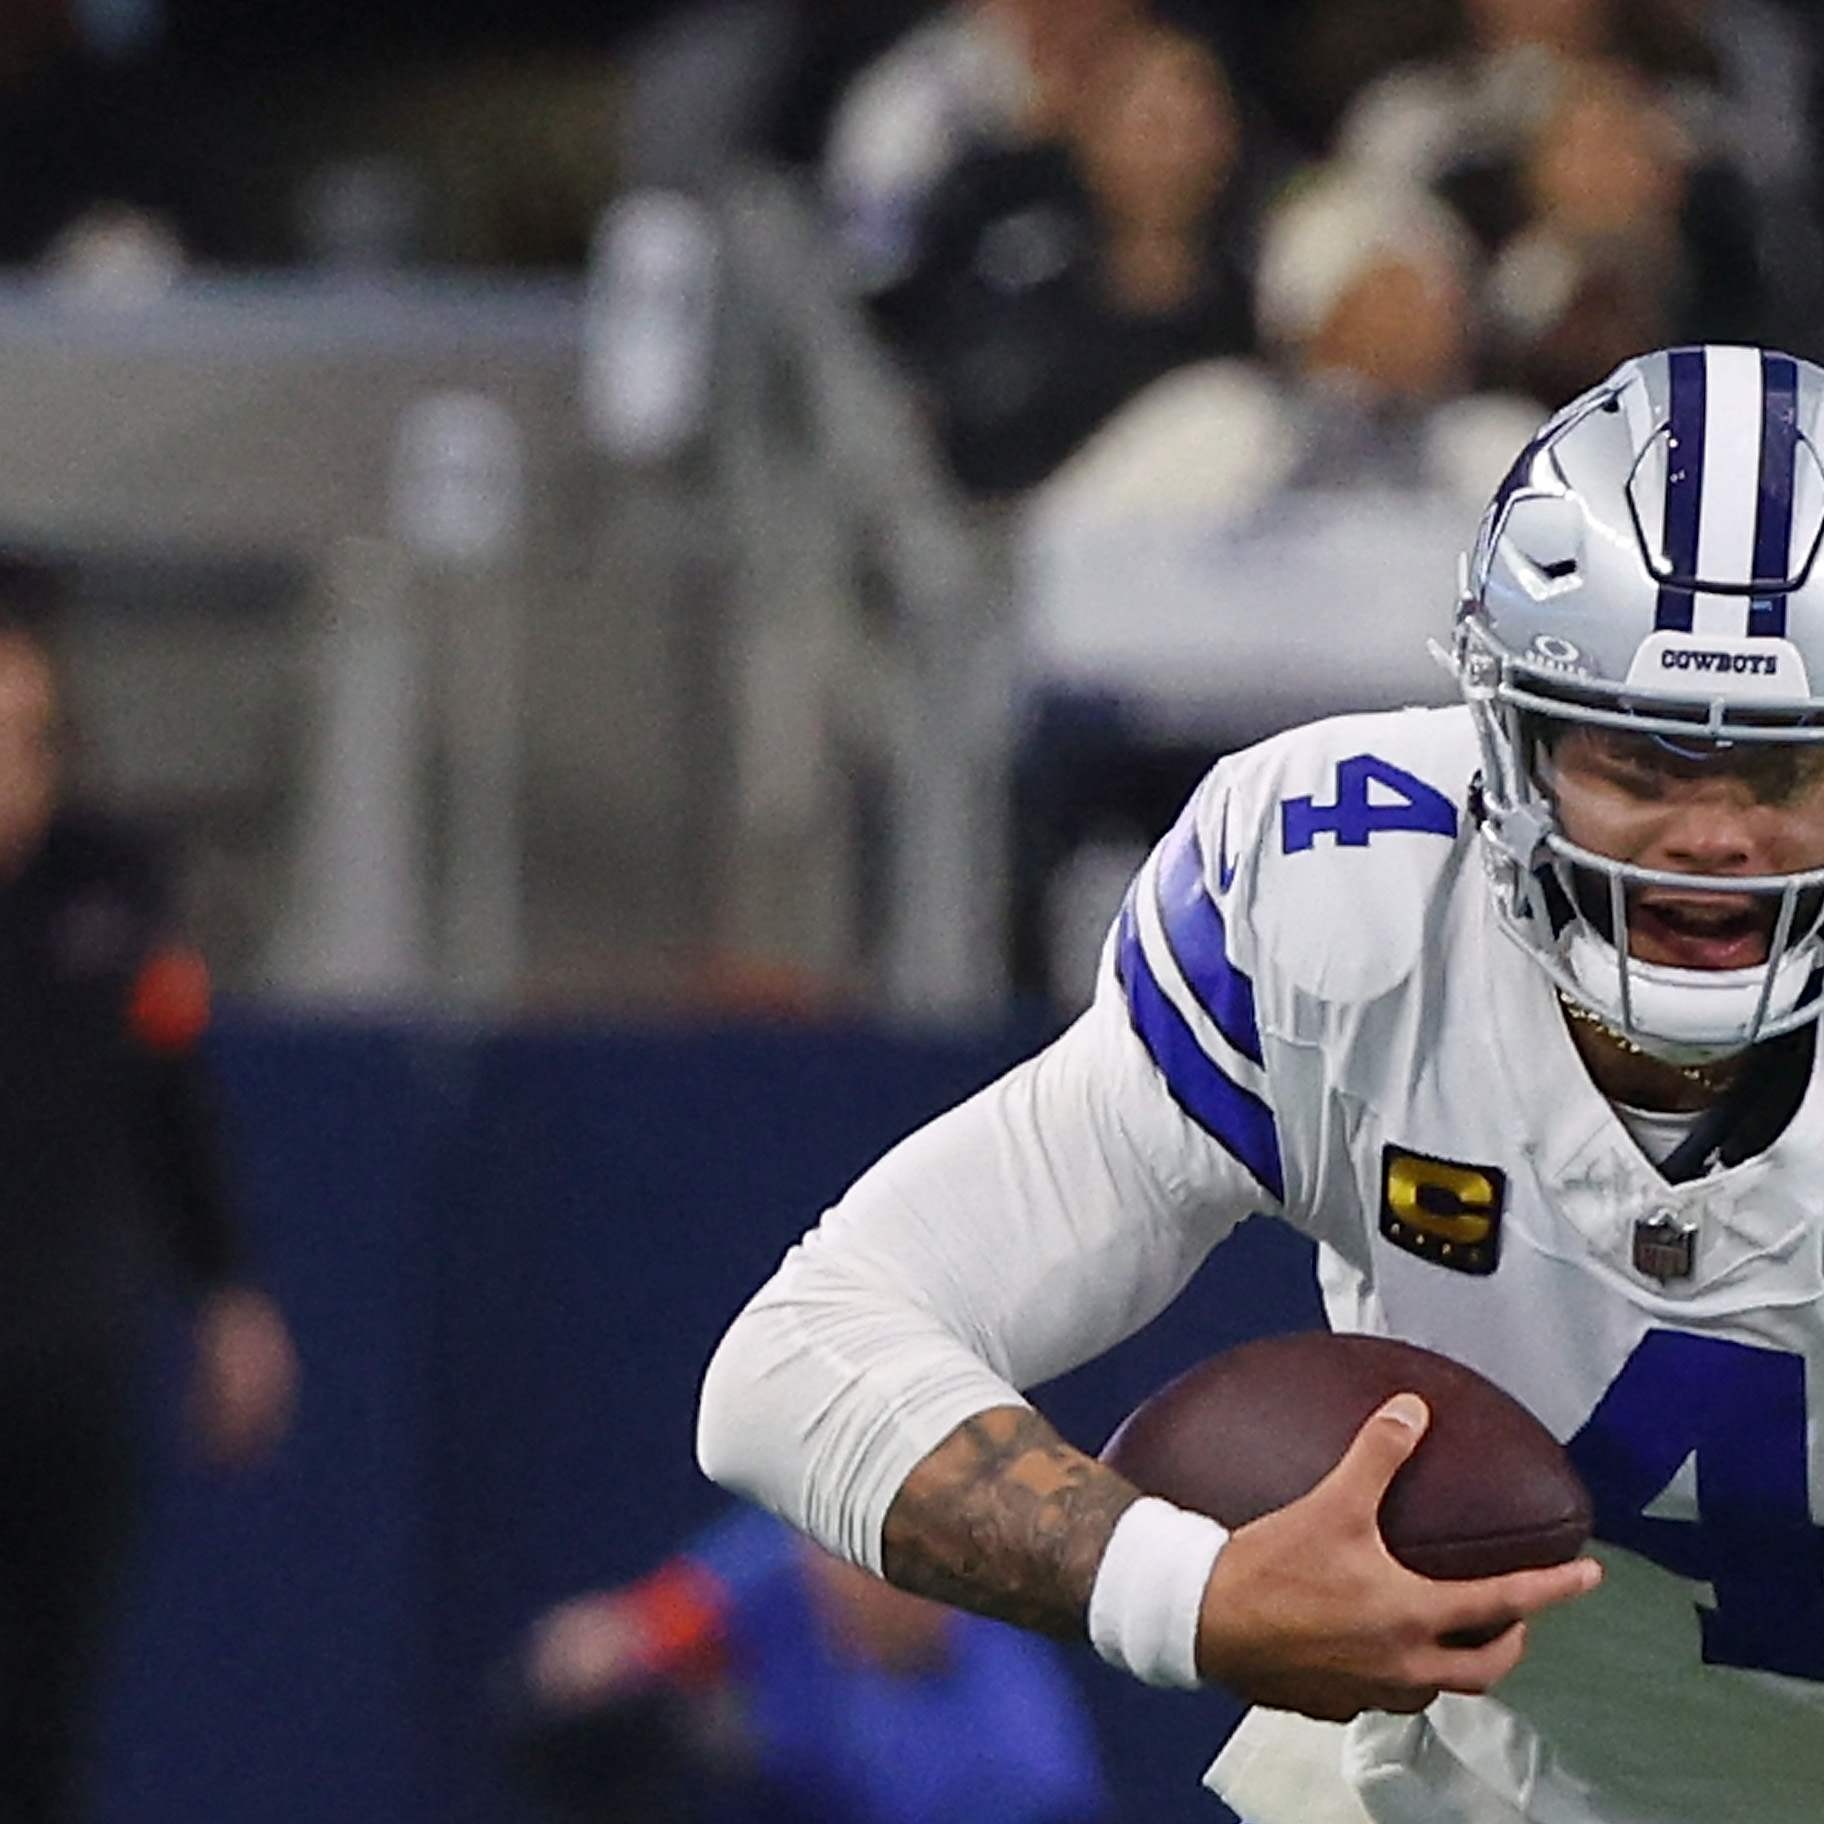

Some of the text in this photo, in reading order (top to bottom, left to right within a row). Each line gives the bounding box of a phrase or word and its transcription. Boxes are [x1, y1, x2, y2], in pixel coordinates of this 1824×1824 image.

[1660, 649, 1778, 675] COWBOYS
[1281, 753, 1459, 857] 4
[1388, 1155, 1493, 1245] C
